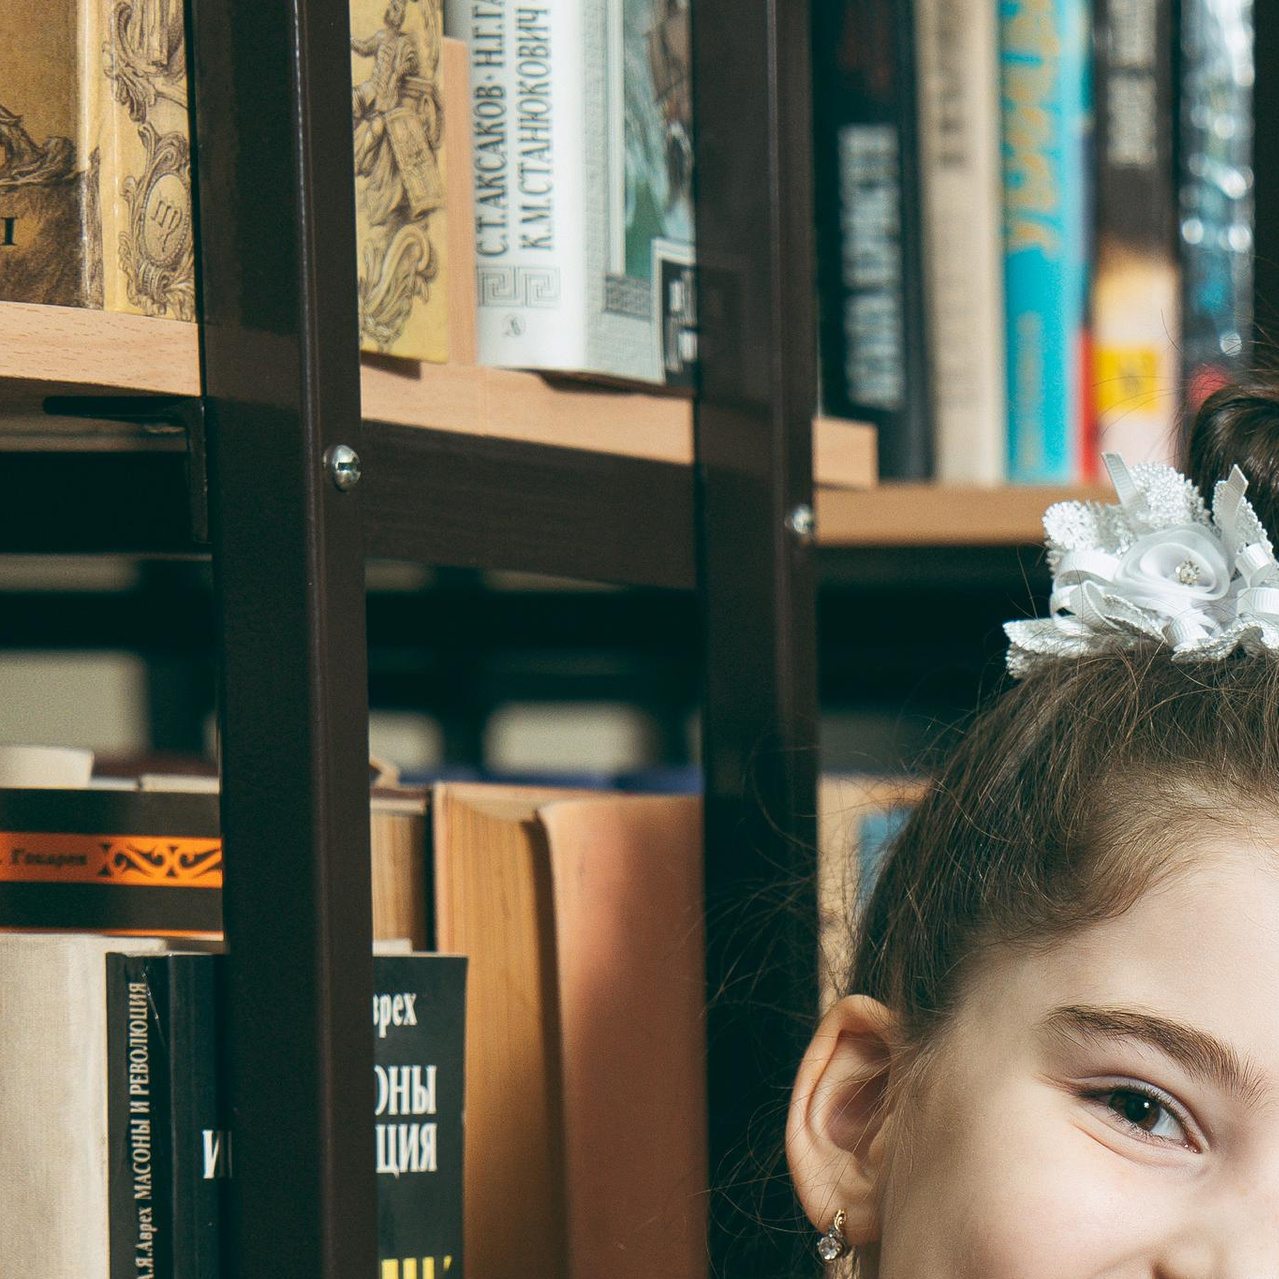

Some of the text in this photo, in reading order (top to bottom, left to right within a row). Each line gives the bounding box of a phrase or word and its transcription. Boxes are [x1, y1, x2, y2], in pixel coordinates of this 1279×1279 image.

[515, 6, 553, 251] К.М.СТАНЮКОВИЧ
[129, 982, 149, 1096] РЕВОЛЮЦИЯ
[130, 1101, 150, 1114] И
[130, 1118, 152, 1200] МАСОНЫ
